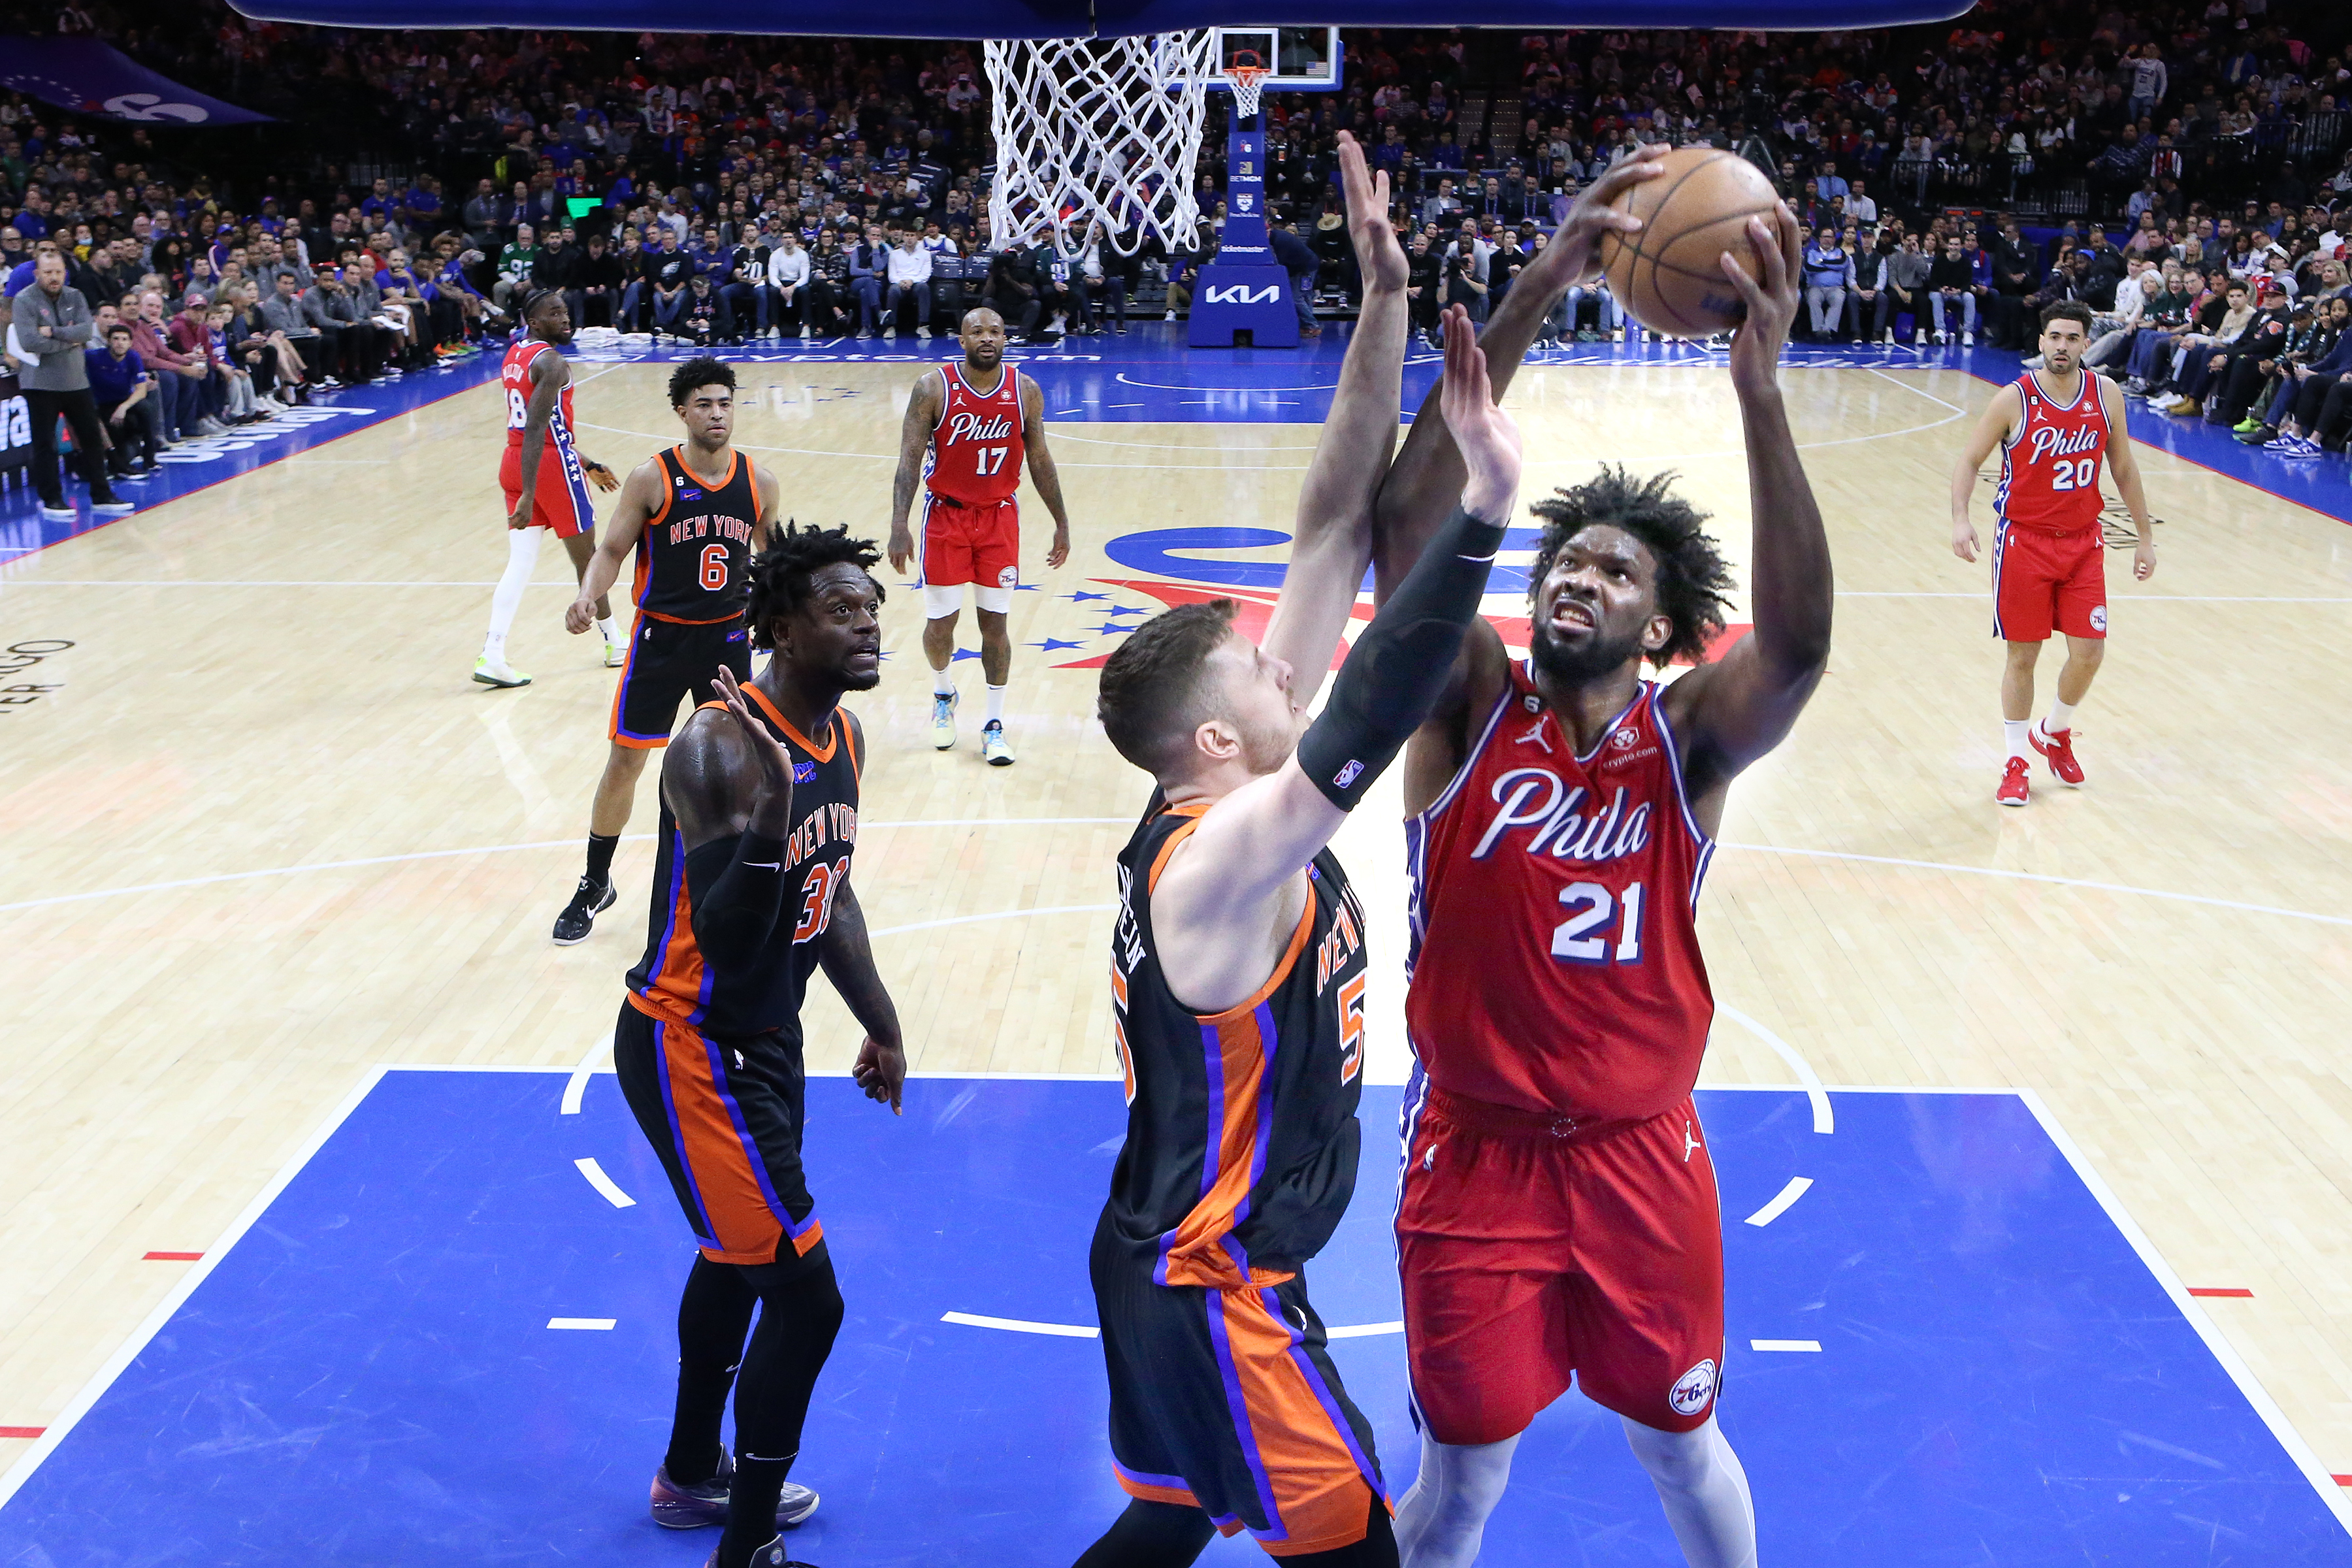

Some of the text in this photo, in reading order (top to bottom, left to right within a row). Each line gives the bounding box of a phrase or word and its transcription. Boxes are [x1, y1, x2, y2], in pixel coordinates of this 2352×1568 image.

[1220, 244, 1266, 253] ticketmaster
[1205, 285, 1280, 304] KIA
[952, 382, 960, 391] 6
[2031, 395, 2039, 406] 6
[947, 412, 1013, 446] Phila
[2029, 424, 2100, 465] Phila
[976, 447, 1009, 476] 17
[2053, 459, 2096, 491] 20
[676, 476, 685, 487] 6
[670, 515, 753, 546] NEW YORK
[698, 544, 729, 591] 6
[1524, 695, 1540, 713] 6
[1603, 746, 1658, 769] crypto.com
[1470, 767, 1652, 860] Phila
[785, 804, 826, 872] NEW
[1551, 881, 1644, 962] 21
[1316, 898, 1360, 998] NEW
